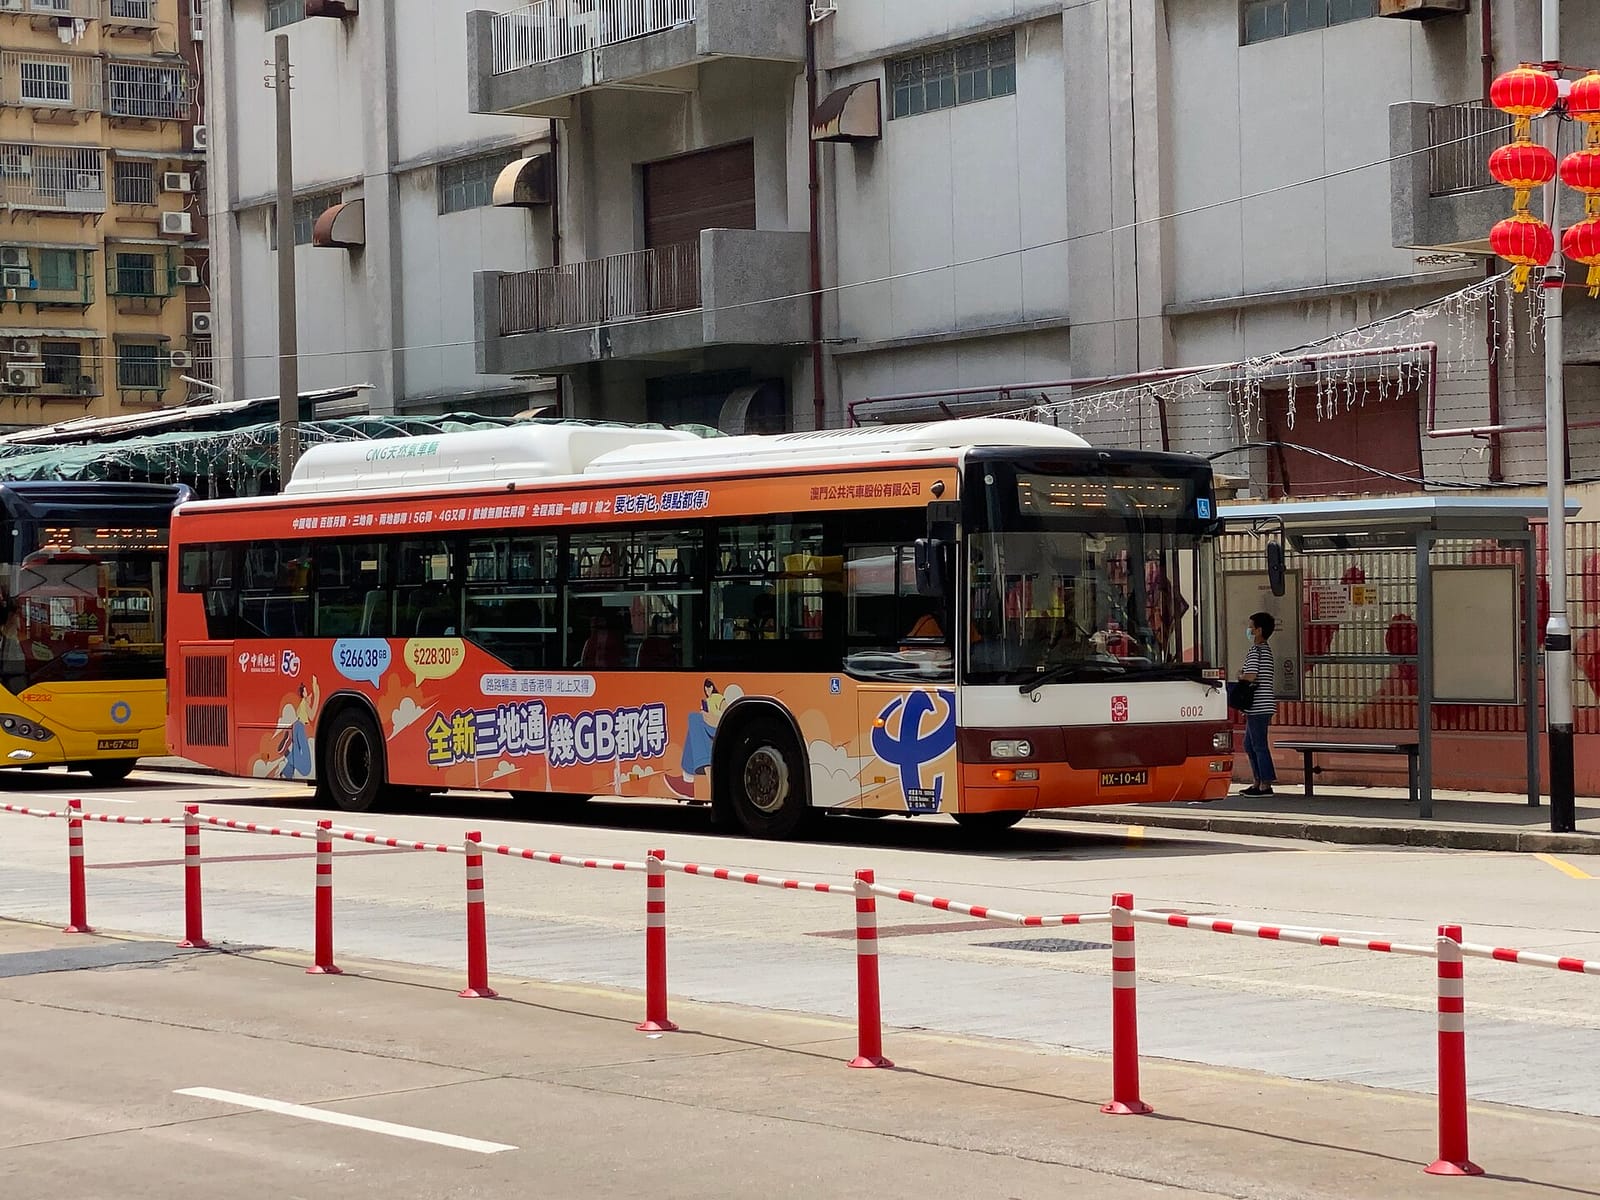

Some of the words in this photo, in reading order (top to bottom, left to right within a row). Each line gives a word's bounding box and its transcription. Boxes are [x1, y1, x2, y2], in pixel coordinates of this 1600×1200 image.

[810, 482, 921, 500] 澳門公共汽車股份有限公司
[281, 650, 300, 677] 5G
[557, 679, 589, 693] 北上又得
[1180, 705, 1204, 718] 6002
[427, 701, 547, 764] 全新三地通
[550, 705, 667, 765] 幾GB都得
[1102, 771, 1147, 786] MX-10-41
